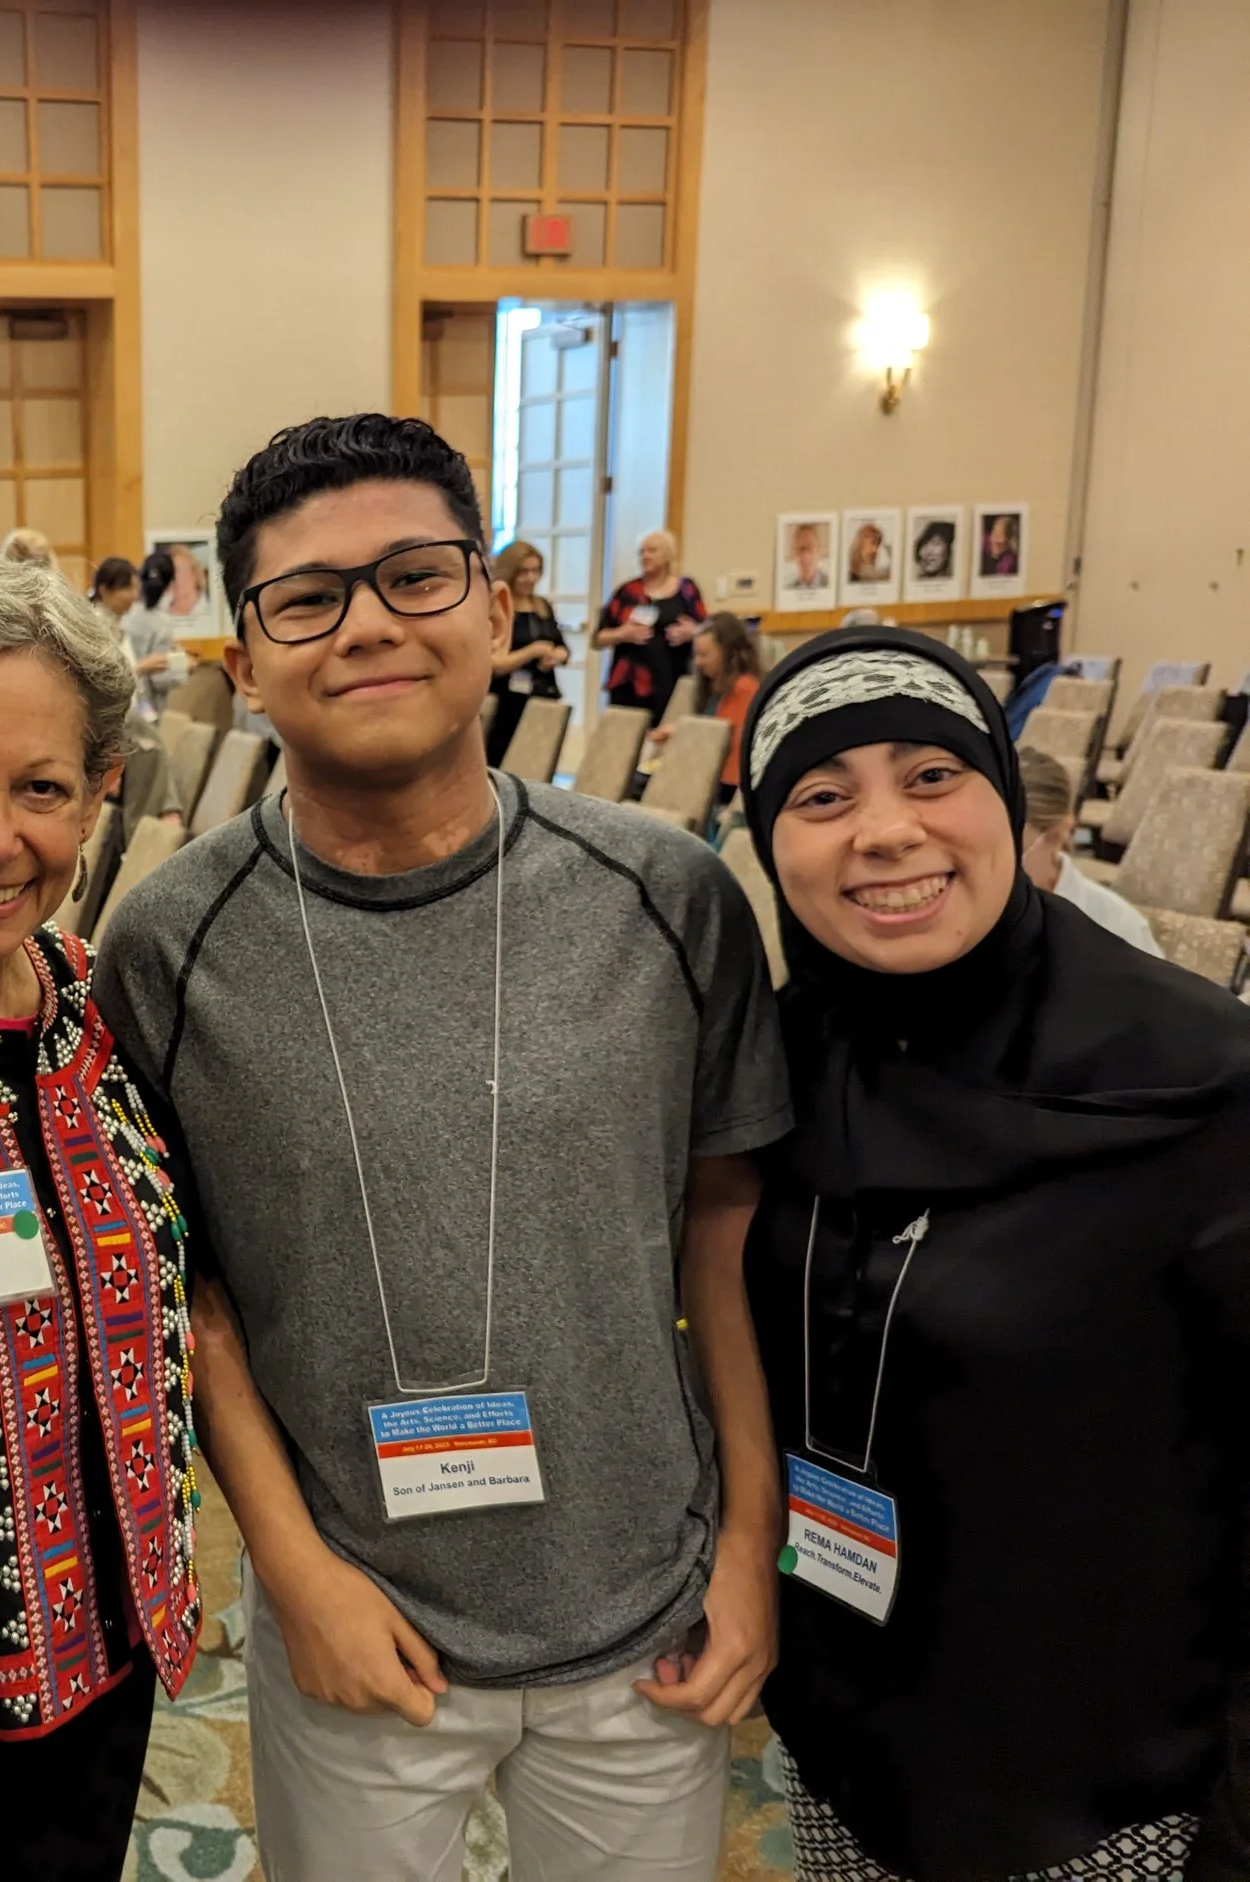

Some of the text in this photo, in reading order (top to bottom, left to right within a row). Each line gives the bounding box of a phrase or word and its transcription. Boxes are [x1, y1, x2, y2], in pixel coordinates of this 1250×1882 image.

[4, 1200, 27, 1210] Place
[390, 1409, 420, 1418] Joyous
[422, 1403, 474, 1414] Celebration
[475, 1401, 485, 1409] of
[486, 1400, 515, 1408] Ideas,
[423, 1414, 462, 1424] Science,
[463, 1411, 481, 1419] and
[481, 1410, 514, 1418] Efforts
[391, 1427, 415, 1436] Make
[416, 1425, 431, 1433] the
[431, 1422, 458, 1432] World
[466, 1420, 495, 1429] Better
[495, 1418, 521, 1427] Place
[440, 1460, 475, 1475] Kenji
[393, 1474, 530, 1496] Son of Jansen and Barbara
[804, 1528, 877, 1574] REMA HAMDAN
